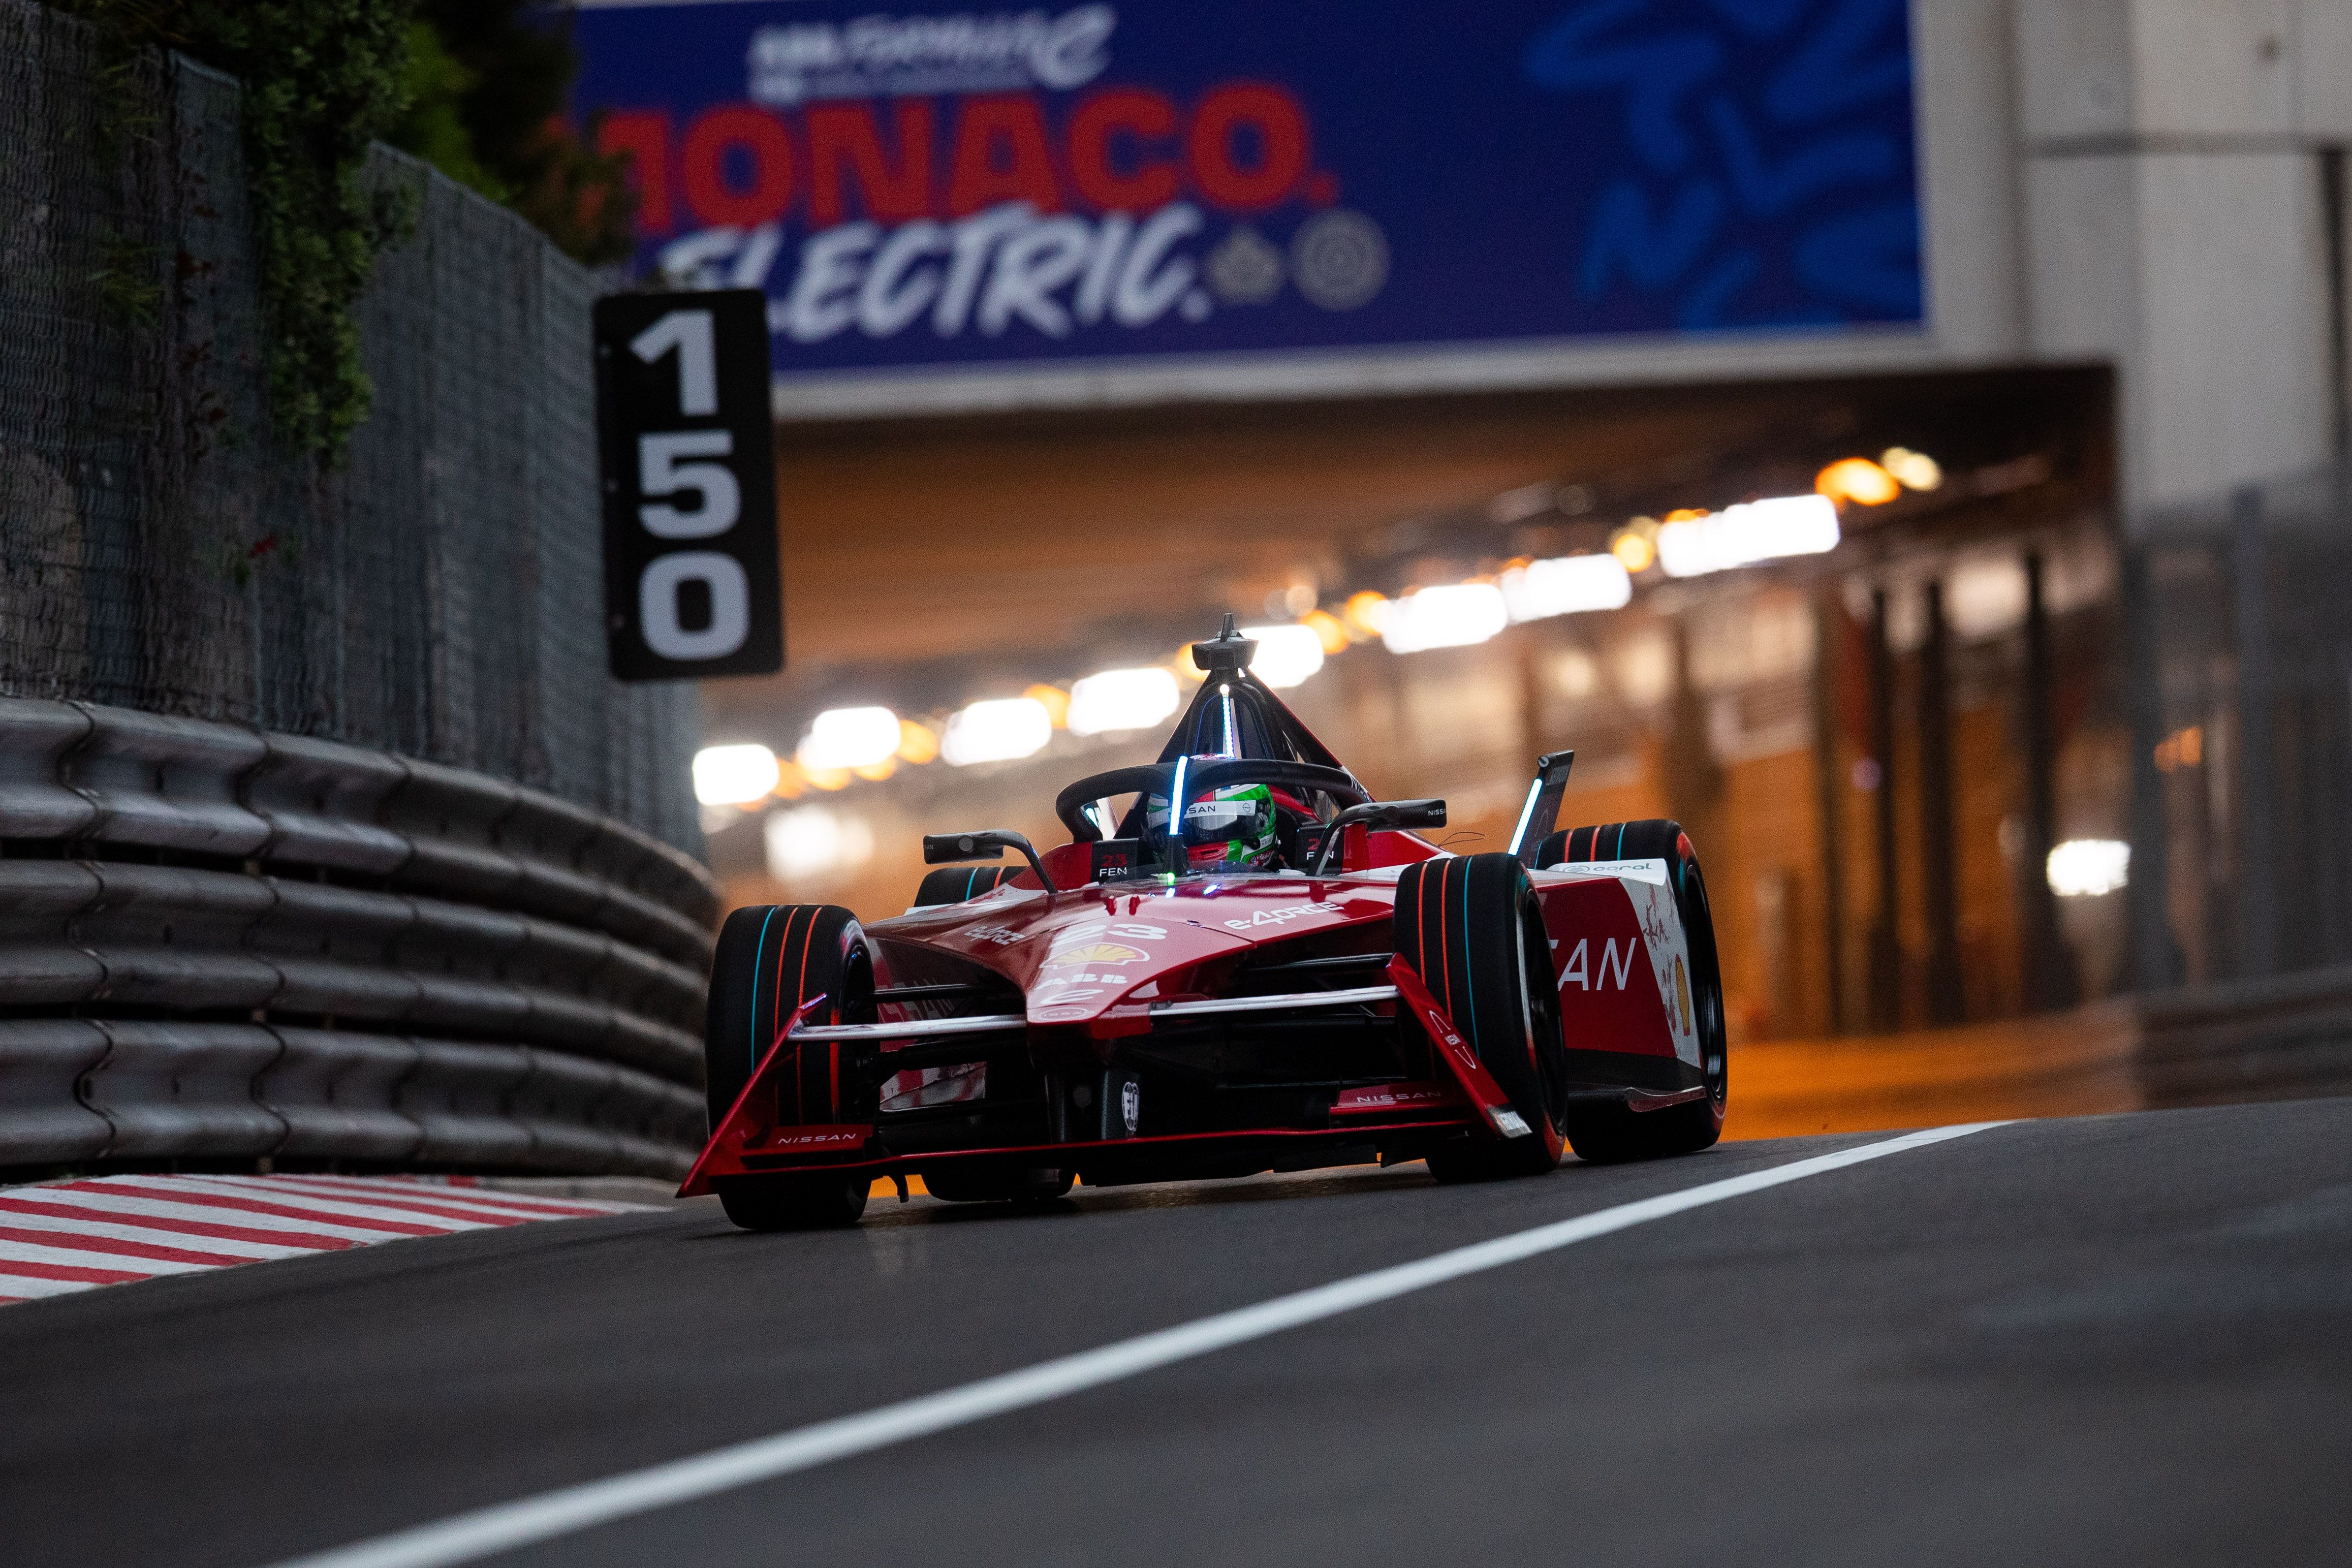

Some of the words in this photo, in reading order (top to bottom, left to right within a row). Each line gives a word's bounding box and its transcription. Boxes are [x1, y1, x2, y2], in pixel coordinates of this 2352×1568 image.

[630, 309, 750, 661] 150
[1188, 805, 1216, 814] SAN
[1307, 838, 1320, 851] 2
[1101, 854, 1127, 867] 23
[1099, 867, 1127, 877] FEN
[1550, 937, 1637, 991] AN
[1357, 1092, 1441, 1103] NISSAN
[778, 1134, 856, 1144] NISSAN
